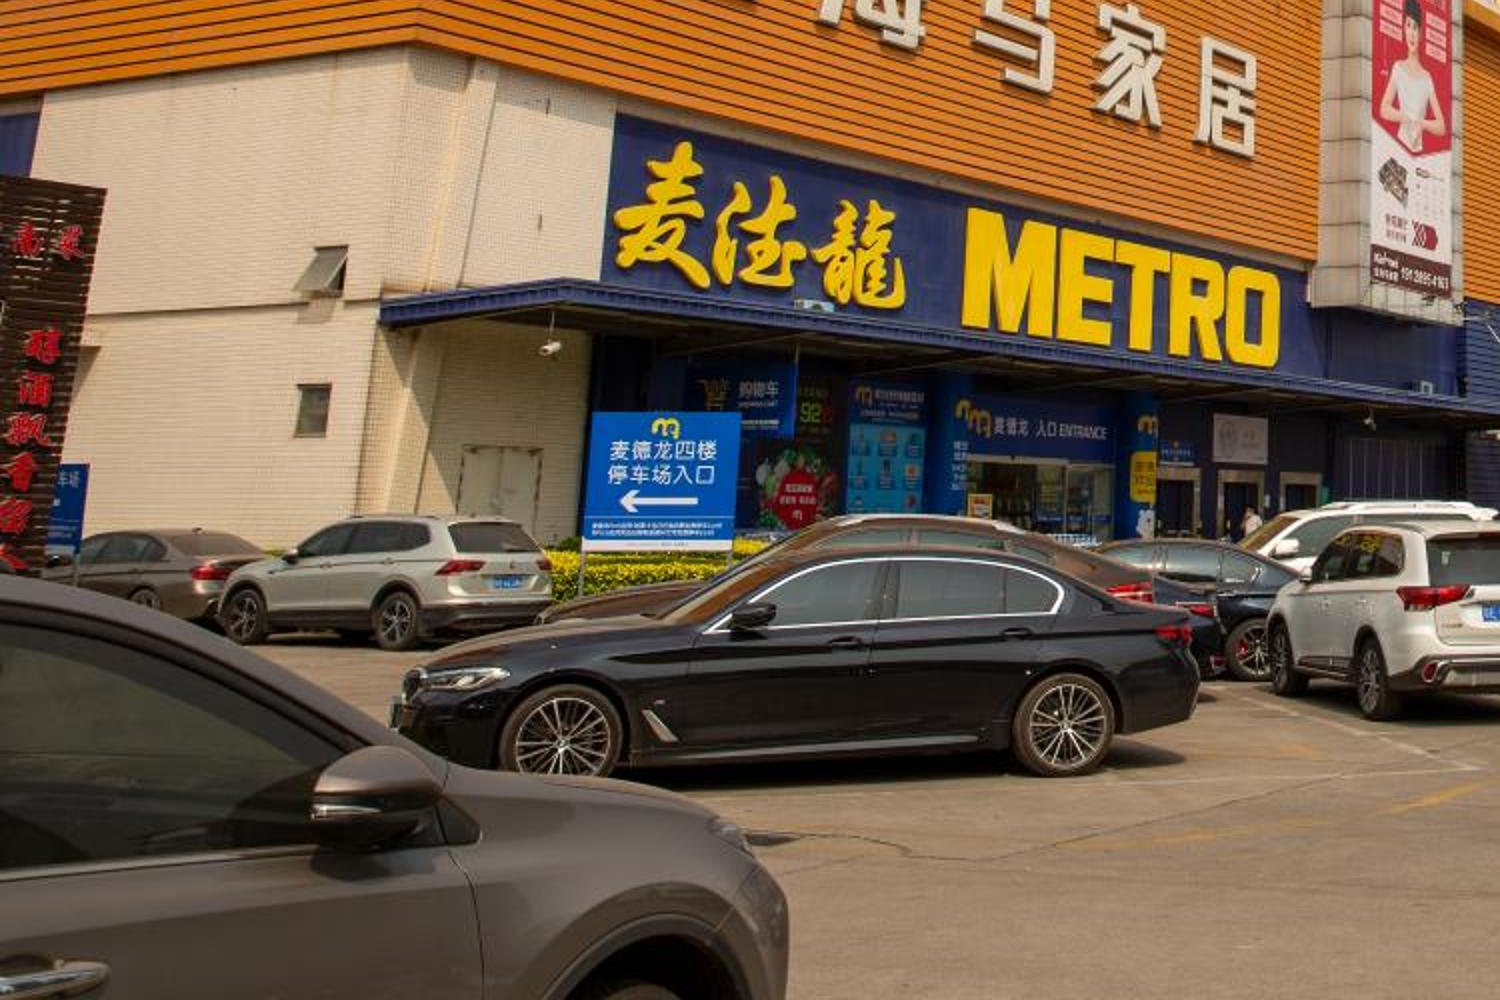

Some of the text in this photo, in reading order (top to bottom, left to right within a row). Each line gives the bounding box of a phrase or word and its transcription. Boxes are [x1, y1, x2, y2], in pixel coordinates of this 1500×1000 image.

[960, 205, 1282, 369] METRO
[994, 415, 1108, 441] 麦德龙 入口 ENTRANCE
[610, 440, 717, 461] 麦德龙四楼
[608, 464, 715, 485] 停车场入口
